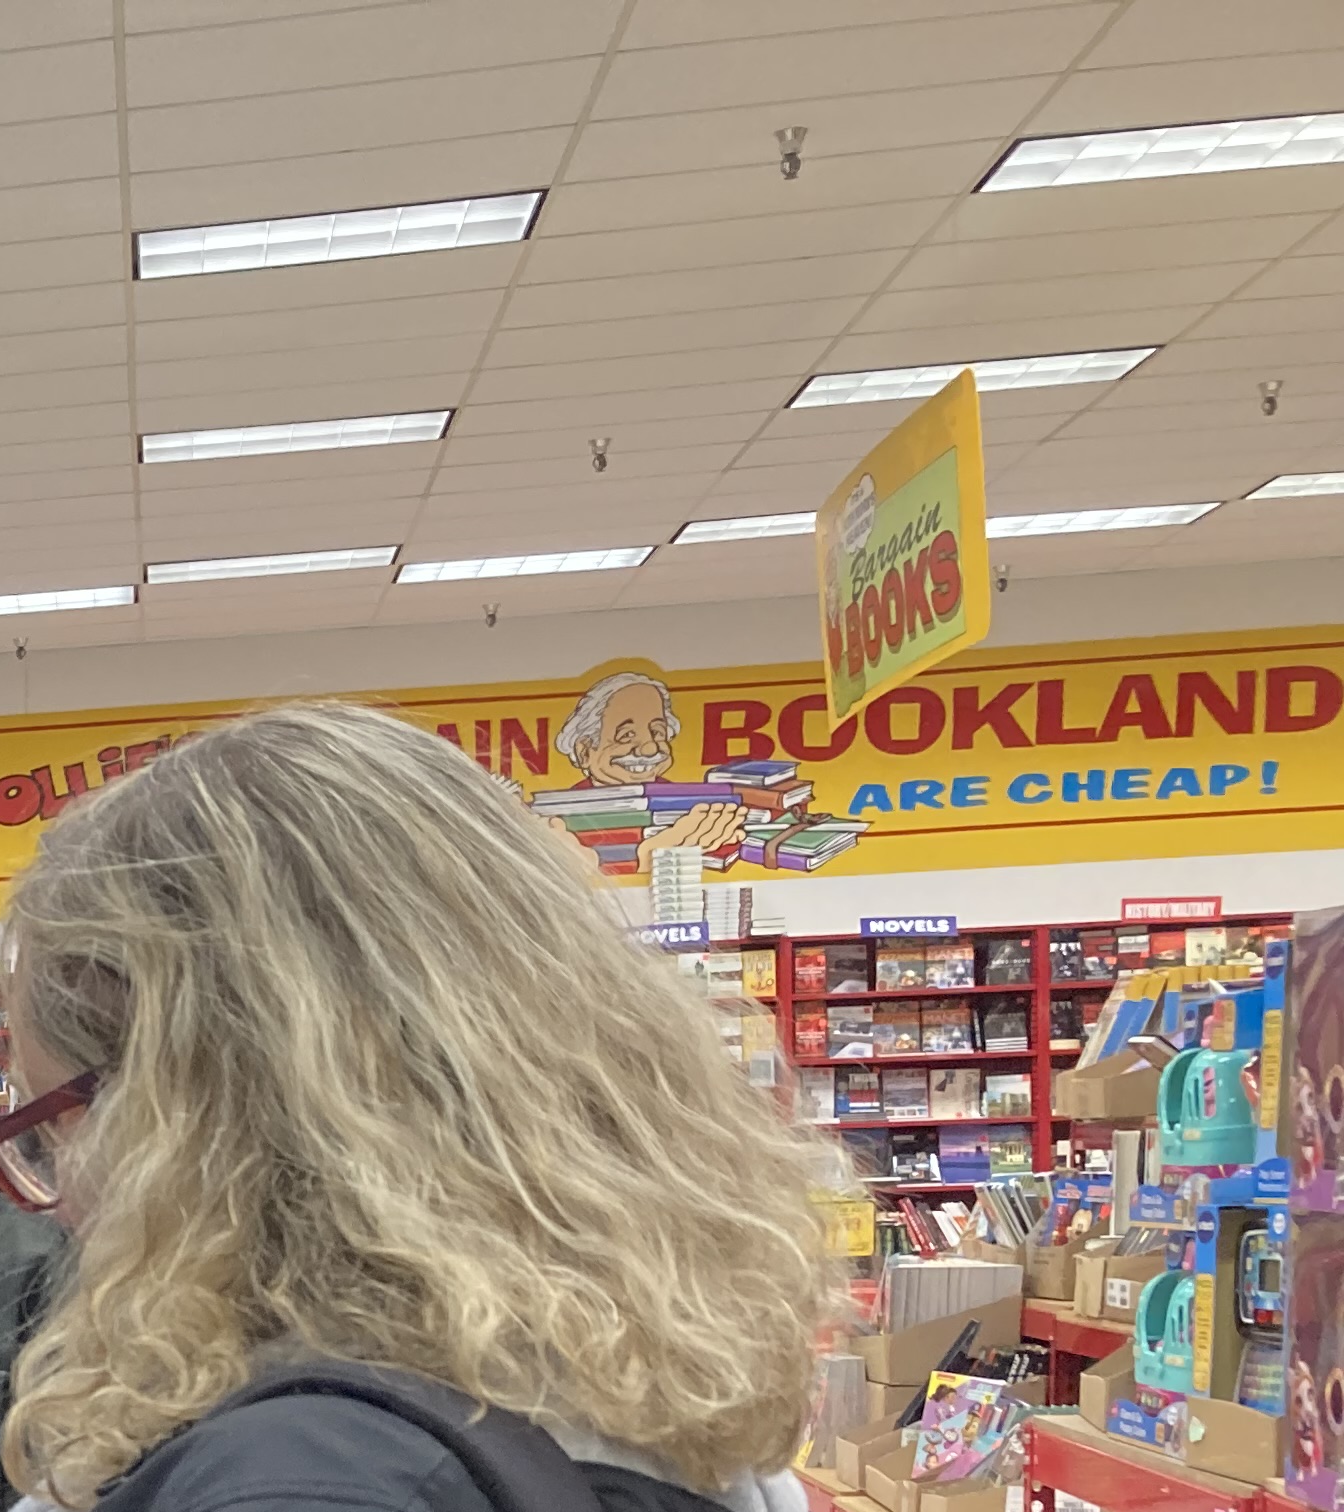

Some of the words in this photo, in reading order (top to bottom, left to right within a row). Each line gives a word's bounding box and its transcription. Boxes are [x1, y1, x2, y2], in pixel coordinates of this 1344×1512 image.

[850, 501, 943, 602] Bargain
[845, 530, 962, 678] BOOKS
[701, 665, 1344, 765] BOOKLAND
[848, 777, 991, 816] ARE
[1006, 761, 1279, 805] CHEAP!
[869, 919, 950, 934] NOVELS
